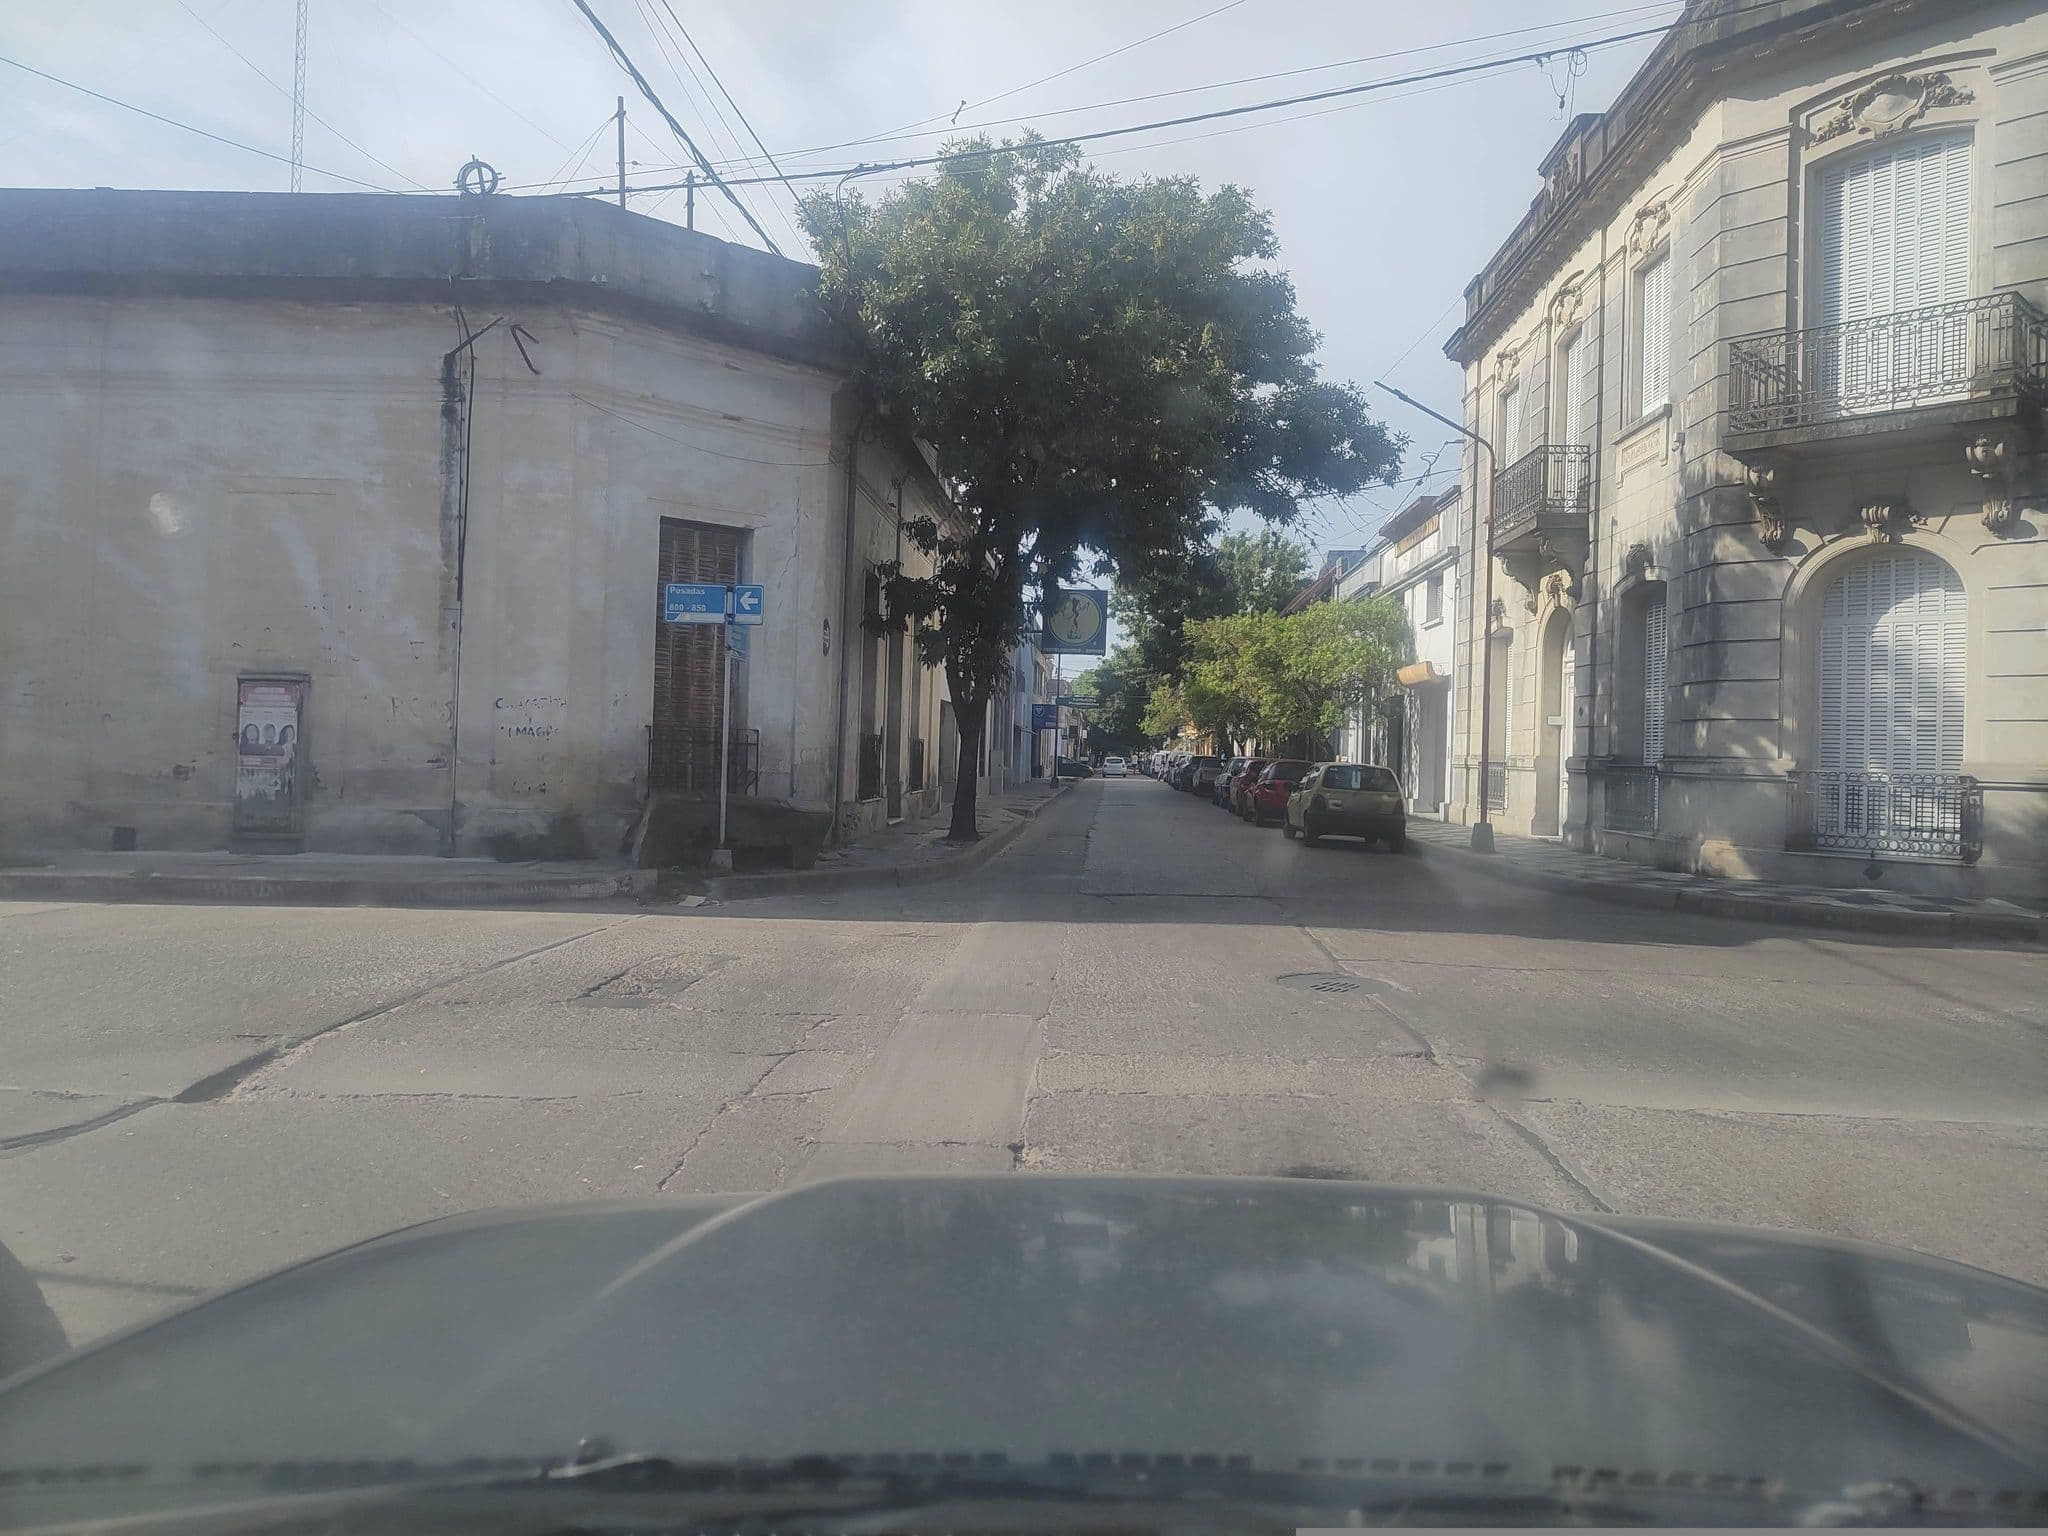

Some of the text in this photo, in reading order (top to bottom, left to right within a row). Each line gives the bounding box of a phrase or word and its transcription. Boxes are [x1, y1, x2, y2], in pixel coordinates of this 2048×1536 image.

[669, 586, 705, 595] Posadas
[669, 603, 684, 611] 800
[691, 604, 707, 612] 850
